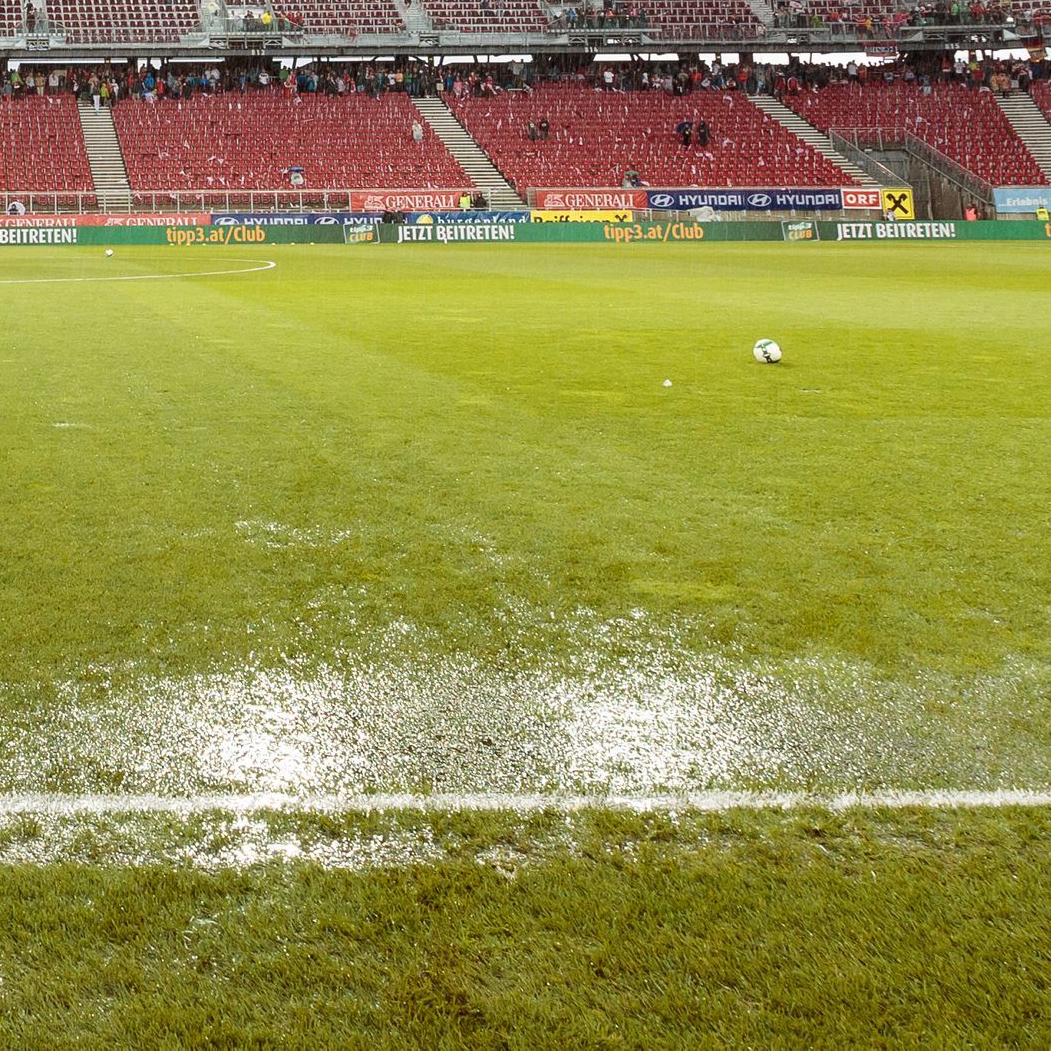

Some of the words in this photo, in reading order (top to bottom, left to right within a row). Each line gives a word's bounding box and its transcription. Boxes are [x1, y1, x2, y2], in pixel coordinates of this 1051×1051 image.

[385, 194, 456, 208] GENERALI
[565, 194, 634, 207] GENERALI
[679, 195, 742, 205] HYUNDAI
[776, 194, 839, 205] HYUNDAI
[846, 194, 878, 205] ORF
[1, 228, 77, 244] BEITRETEN!
[166, 226, 266, 245] tipp3.at/Club
[398, 226, 433, 243] JETZT
[436, 225, 515, 240] BEITRETEN!
[604, 223, 704, 243] tipp3.at/Club
[837, 223, 873, 241] JETZT
[876, 223, 956, 238] BEITRETEN!
